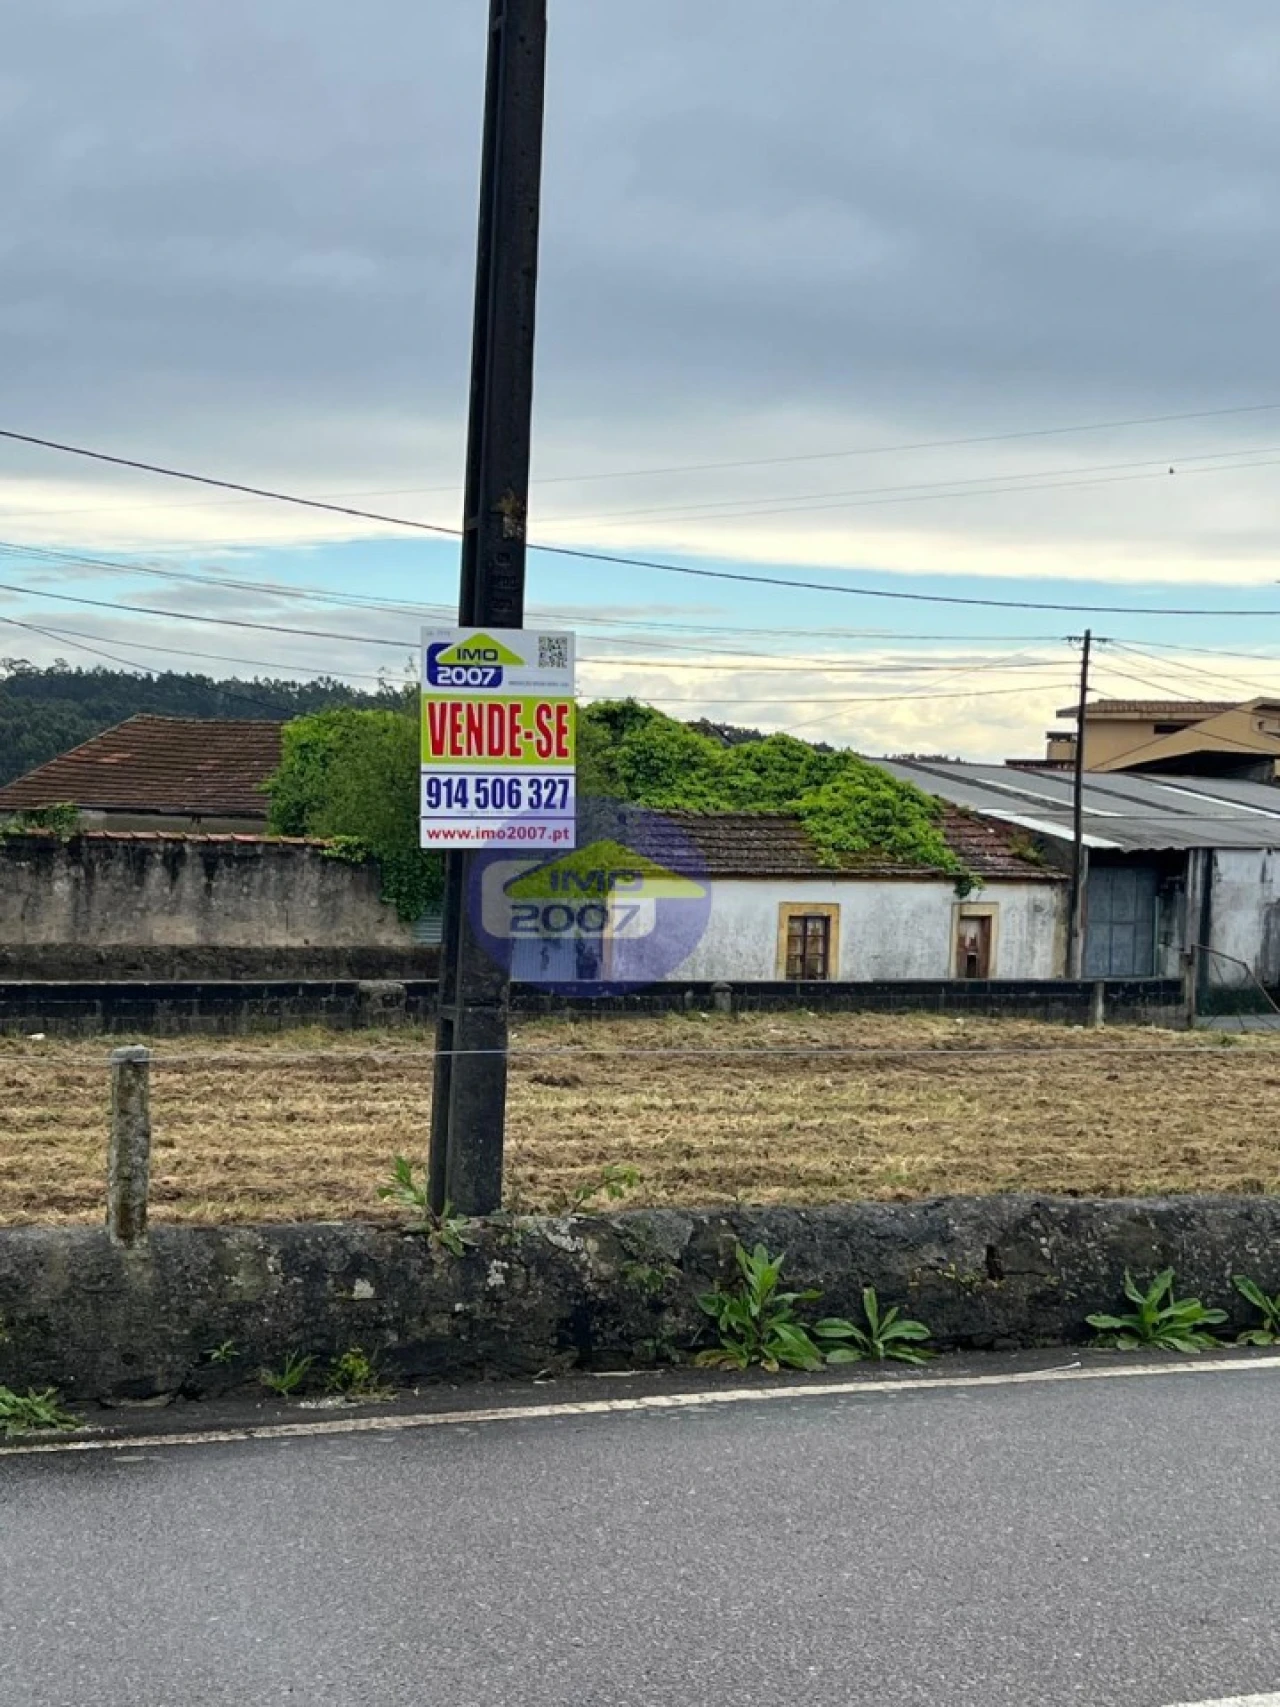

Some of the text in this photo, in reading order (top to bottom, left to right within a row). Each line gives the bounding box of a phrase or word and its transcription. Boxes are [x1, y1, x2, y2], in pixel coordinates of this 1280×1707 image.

[456, 648, 498, 662] IMO
[436, 667, 496, 685] 2007
[427, 701, 570, 758] VENDE-SE
[426, 777, 570, 810] 914 506 327
[426, 826, 570, 842] www.imo2007.pt
